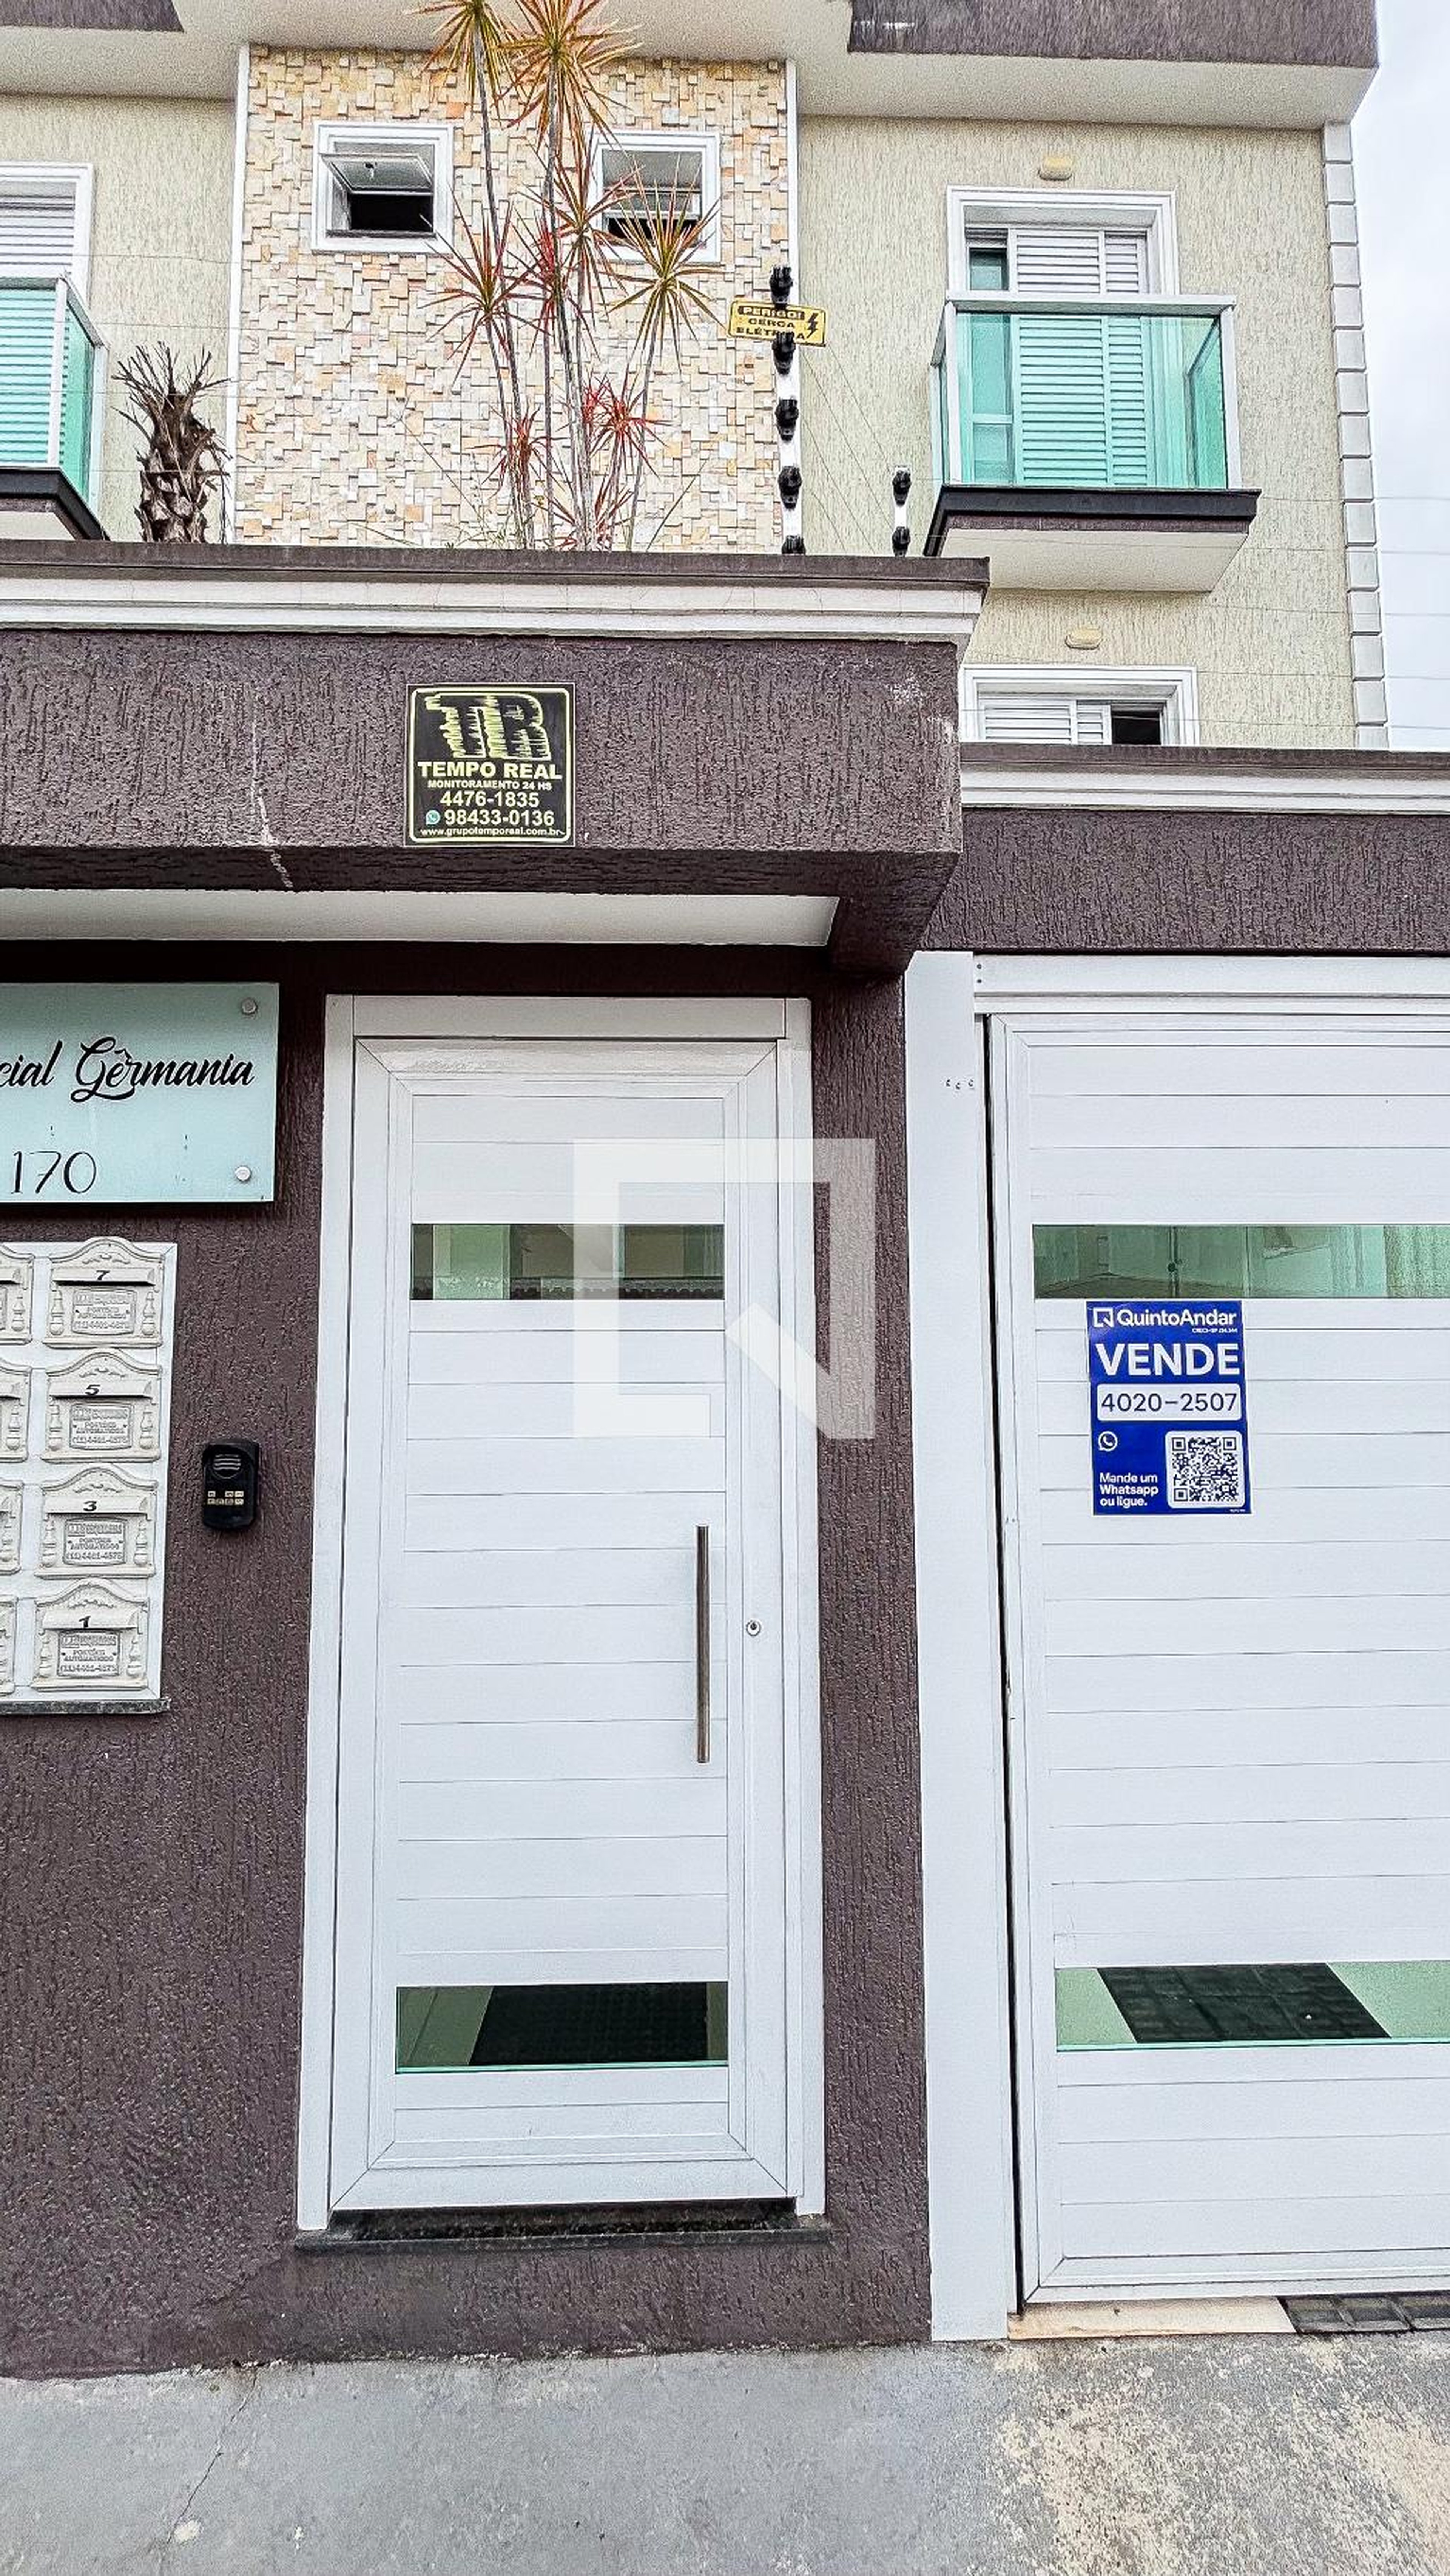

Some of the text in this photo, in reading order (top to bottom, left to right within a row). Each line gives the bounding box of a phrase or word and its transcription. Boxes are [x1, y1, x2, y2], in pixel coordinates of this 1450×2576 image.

[748, 318, 795, 328] CERCA
[417, 761, 562, 780] TEMPO REAL
[427, 779, 552, 791] MONITORAMENTO 24 HS
[440, 791, 539, 807] 4476-1835
[444, 809, 554, 826] 98433-0136
[420, 827, 561, 836] www.grupotemporeal.com.br
[11, 1151, 96, 1194] 170
[96, 1270, 110, 1281] 7
[1117, 1308, 1236, 1327] QuintoAndar
[1095, 1343, 1240, 1377] VENDE
[85, 1384, 100, 1395] 5
[1101, 1392, 1237, 1412] 4020-2507
[1100, 1473, 1138, 1483] Mande
[1100, 1484, 1159, 1496] Whatsapp
[83, 1500, 97, 1512] 3
[1100, 1497, 1148, 1508] ou ligue.
[79, 1615, 91, 1628] 1
